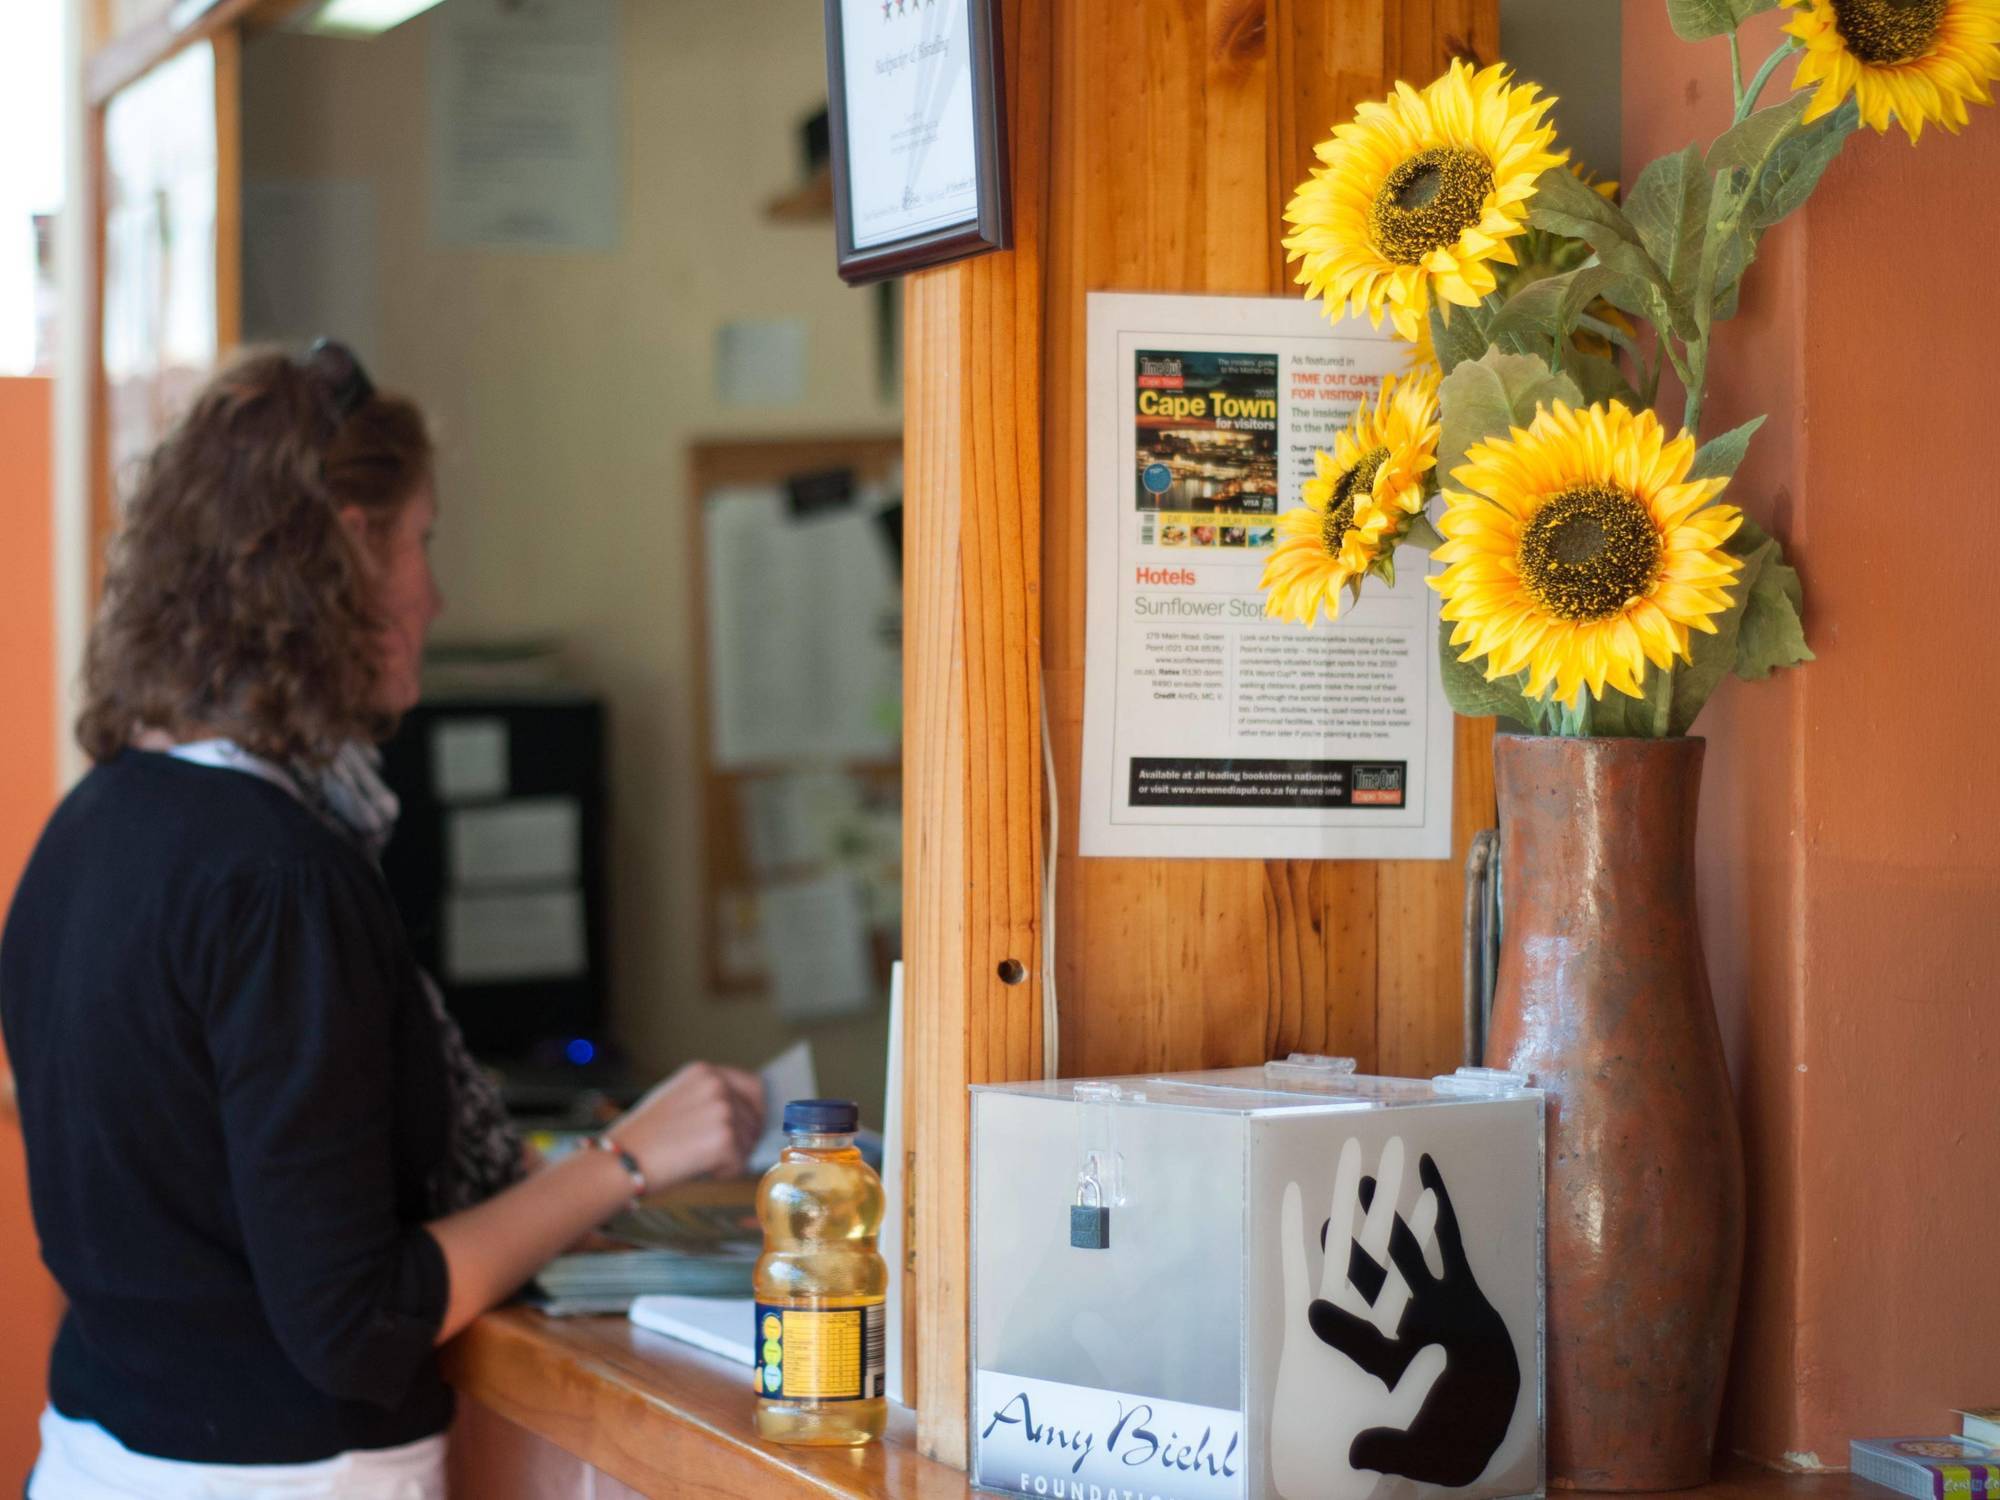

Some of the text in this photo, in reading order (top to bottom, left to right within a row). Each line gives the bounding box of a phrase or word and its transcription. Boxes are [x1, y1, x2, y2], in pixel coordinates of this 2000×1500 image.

[1291, 356, 1355, 367] As featured in
[1291, 373, 1320, 384] TIME
[1323, 374, 1346, 385] OUT
[1349, 375, 1378, 386] CAPE
[1291, 388, 1315, 400] FOR
[1139, 391, 1276, 421] Cape Town
[1292, 408, 1310, 417] The
[1216, 418, 1275, 430] for visitors
[1291, 423, 1322, 433] to the
[1136, 568, 1196, 585] Hotels
[1135, 597, 1225, 616] Sunflower
[1139, 770, 1343, 782] Available at all leading bookstores nationwide
[1150, 785, 1169, 793] visit
[1171, 786, 1284, 796] www.newmediapub.co.za
[1285, 787, 1298, 795] for
[1300, 788, 1323, 796] more
[1325, 787, 1341, 796] info
[982, 1392, 1239, 1477] Amy Biehl
